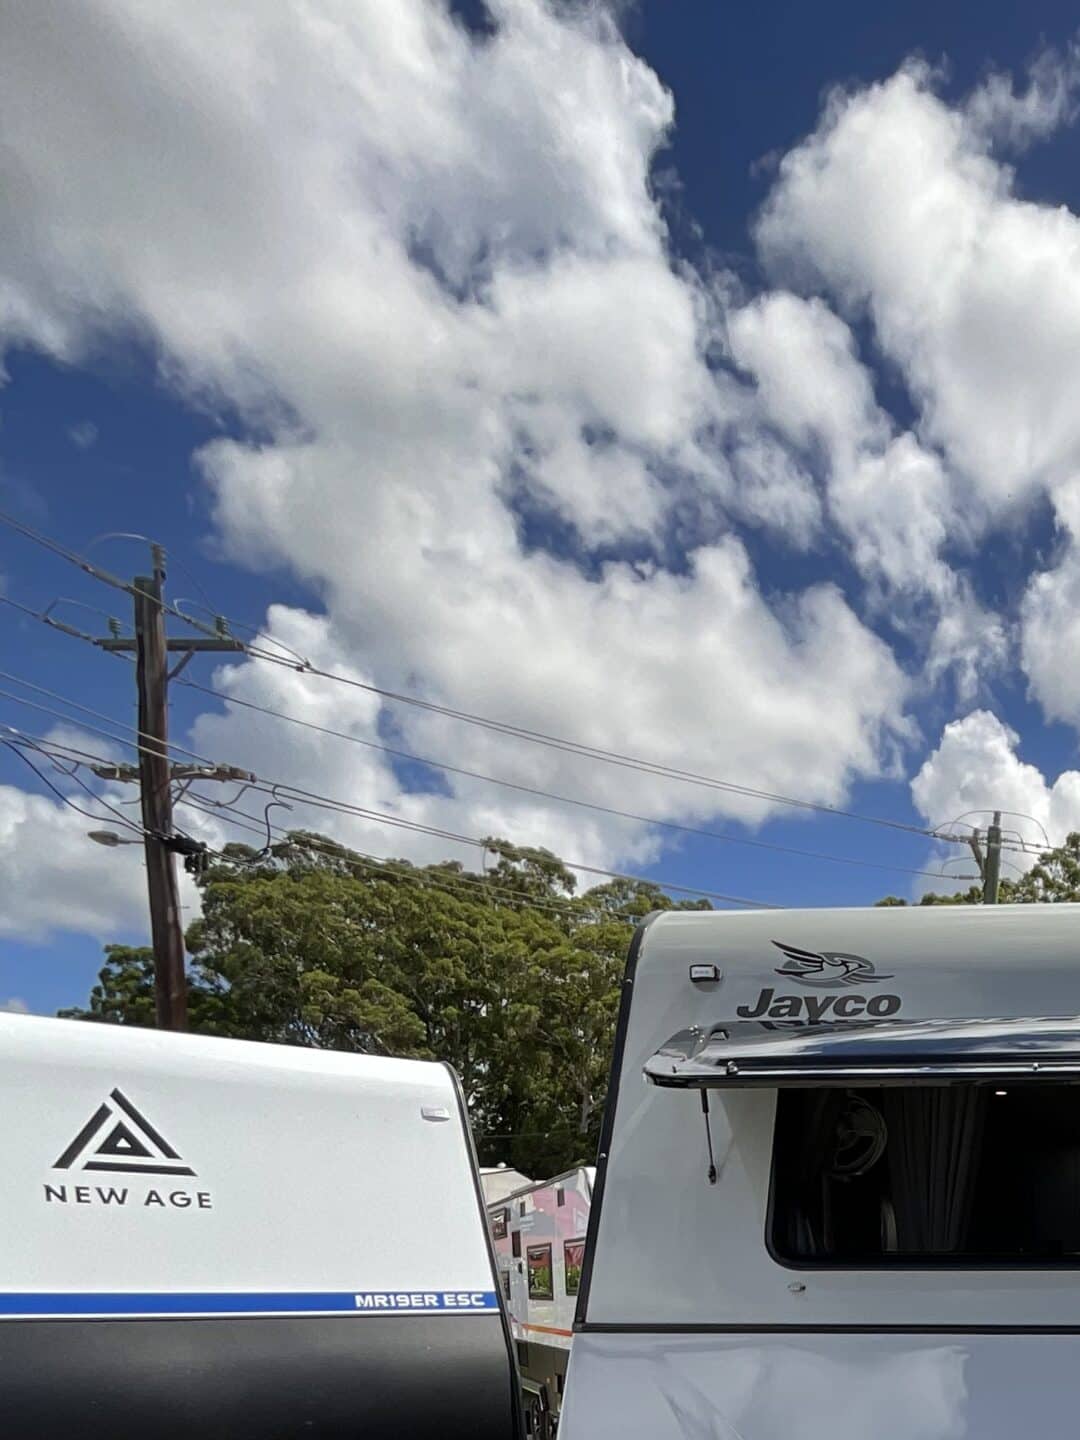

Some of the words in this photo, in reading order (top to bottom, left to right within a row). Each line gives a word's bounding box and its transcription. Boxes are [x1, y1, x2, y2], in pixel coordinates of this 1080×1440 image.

[736, 988, 902, 1026] Jayco
[43, 1184, 128, 1205] NEW
[144, 1190, 212, 1209] AGE
[354, 1294, 439, 1308] MR19ER
[443, 1293, 486, 1307] ESC
